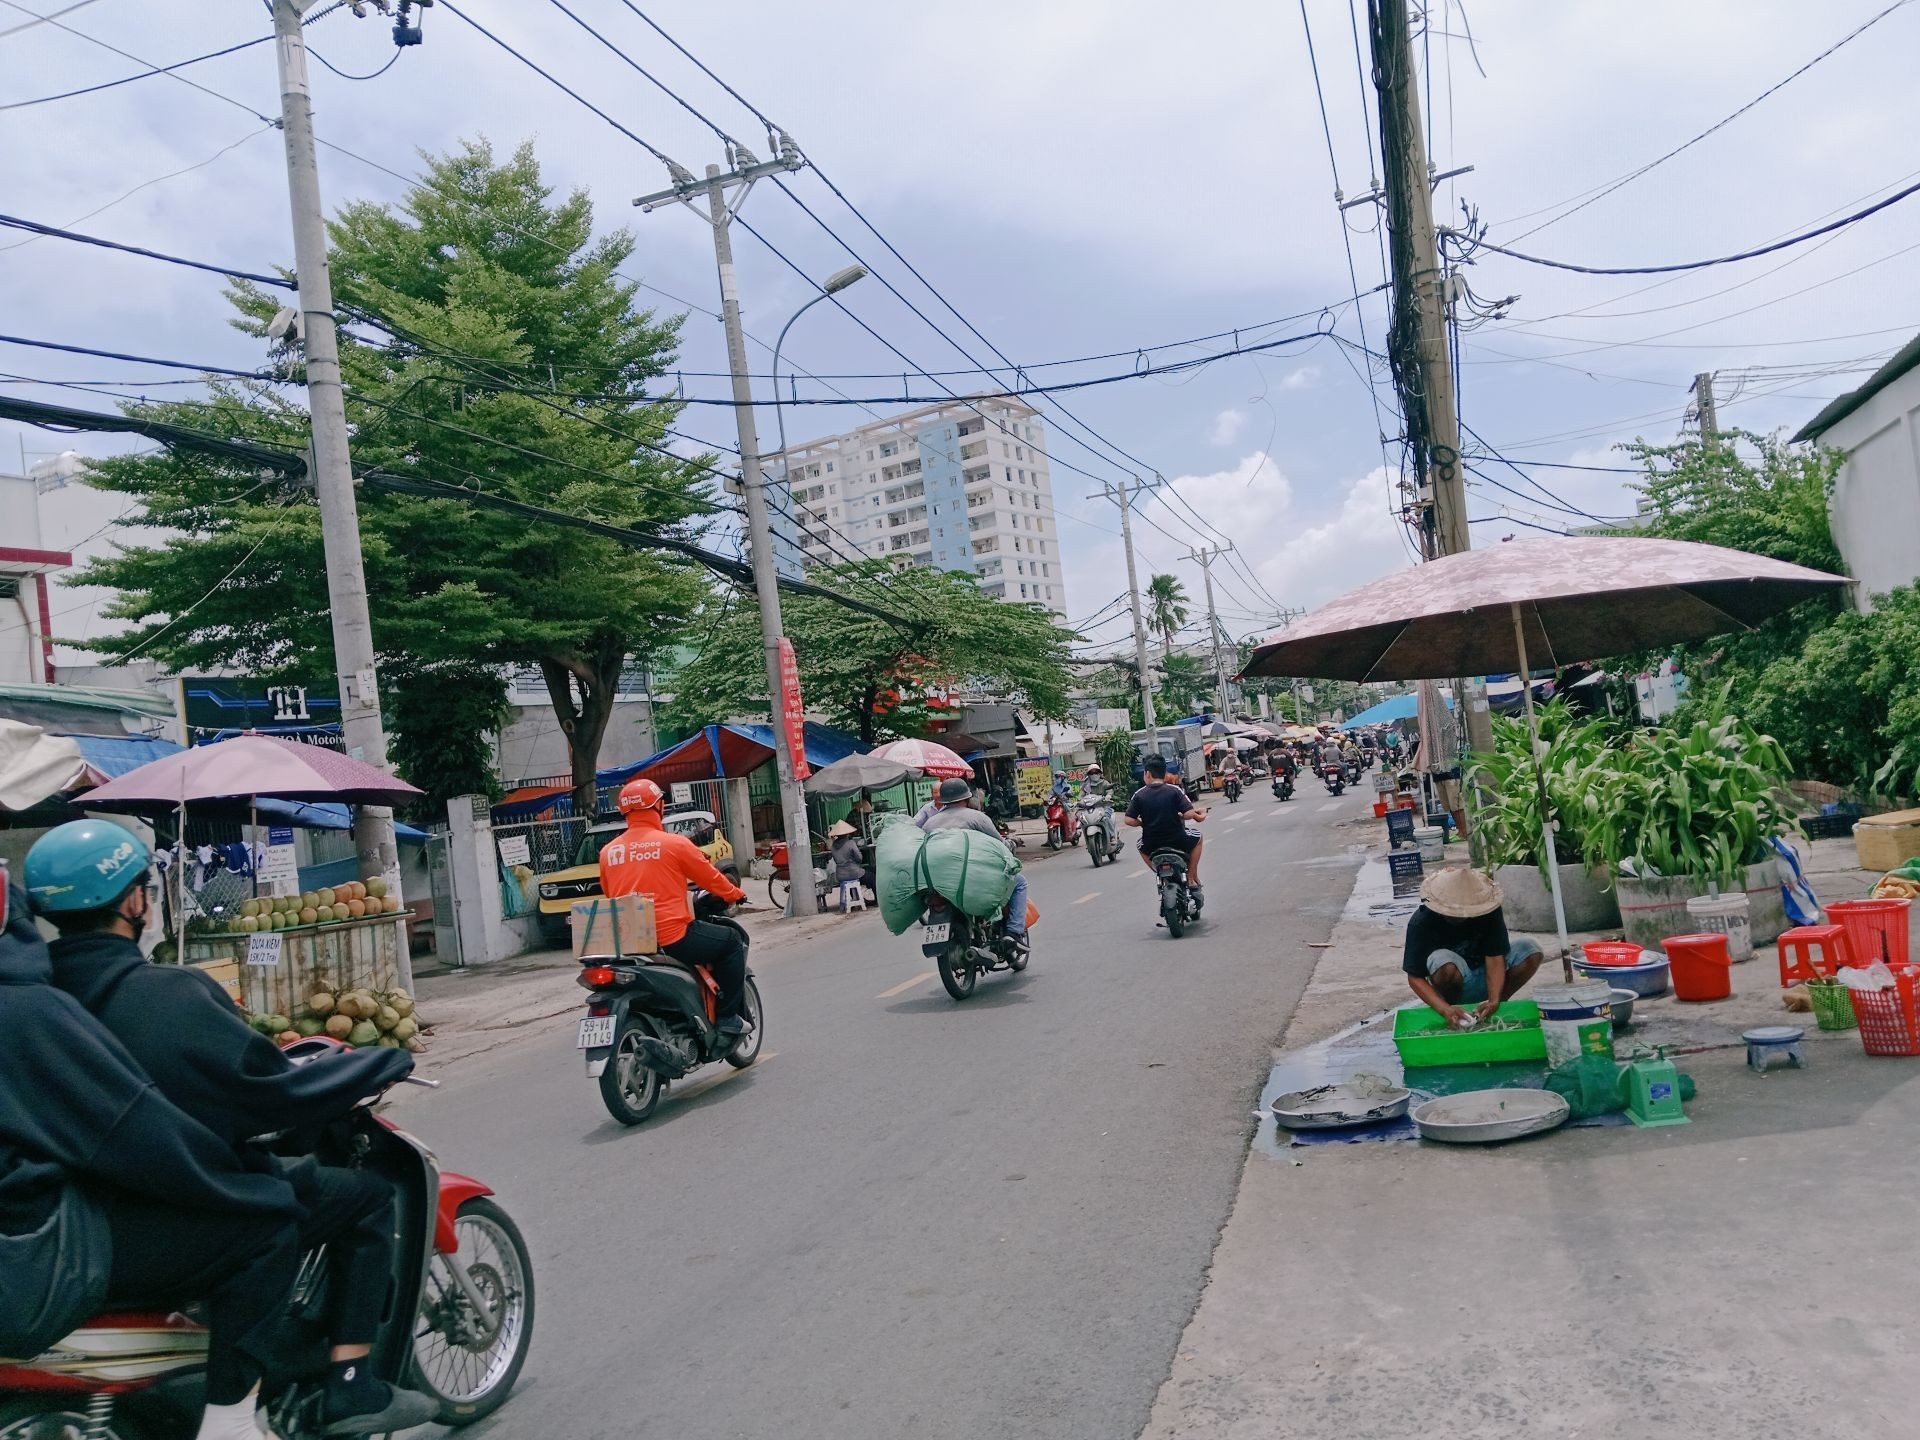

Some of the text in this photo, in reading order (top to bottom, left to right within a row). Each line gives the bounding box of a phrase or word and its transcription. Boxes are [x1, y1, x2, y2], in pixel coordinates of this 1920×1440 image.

[472, 799, 486, 808] 257
[630, 841, 661, 850] Shopee
[629, 848, 661, 862] Food
